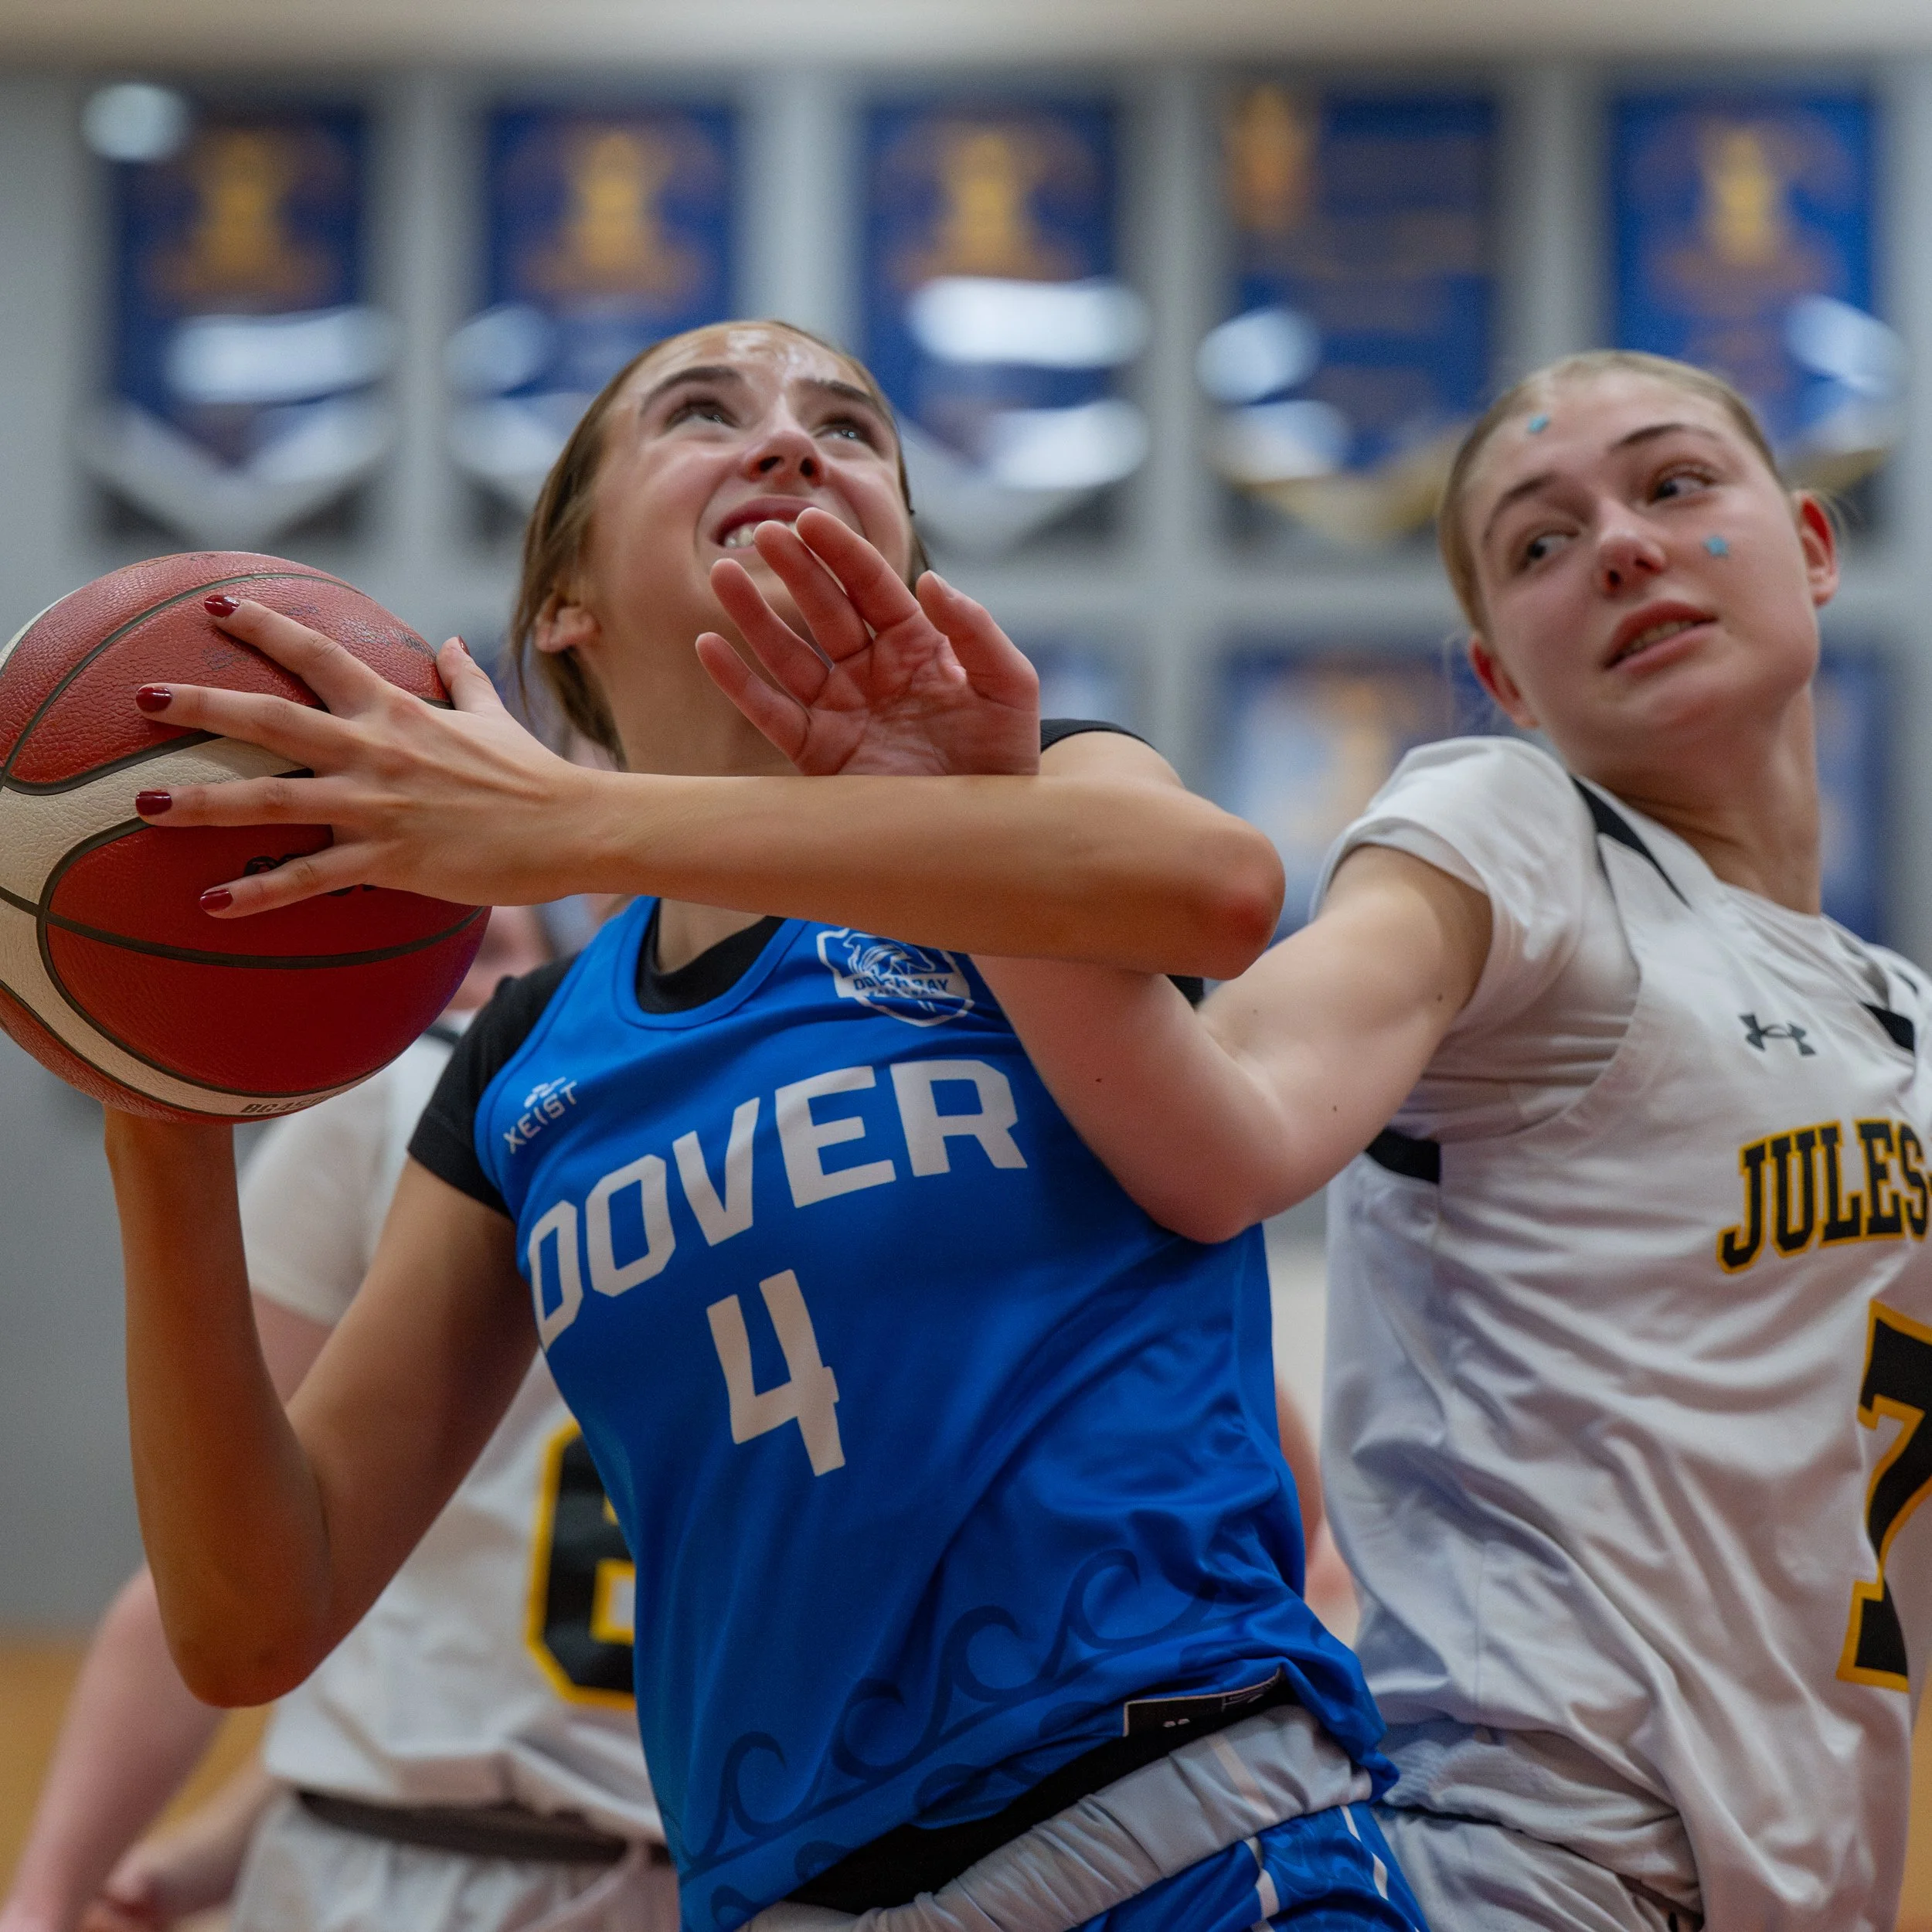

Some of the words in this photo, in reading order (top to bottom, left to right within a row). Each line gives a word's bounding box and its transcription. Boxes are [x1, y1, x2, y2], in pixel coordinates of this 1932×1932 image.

[503, 1080, 578, 1155] XEIST
[528, 1060, 1028, 1354] DOVER
[1716, 1116, 1932, 1274] JULES
[706, 1268, 846, 1477] 4
